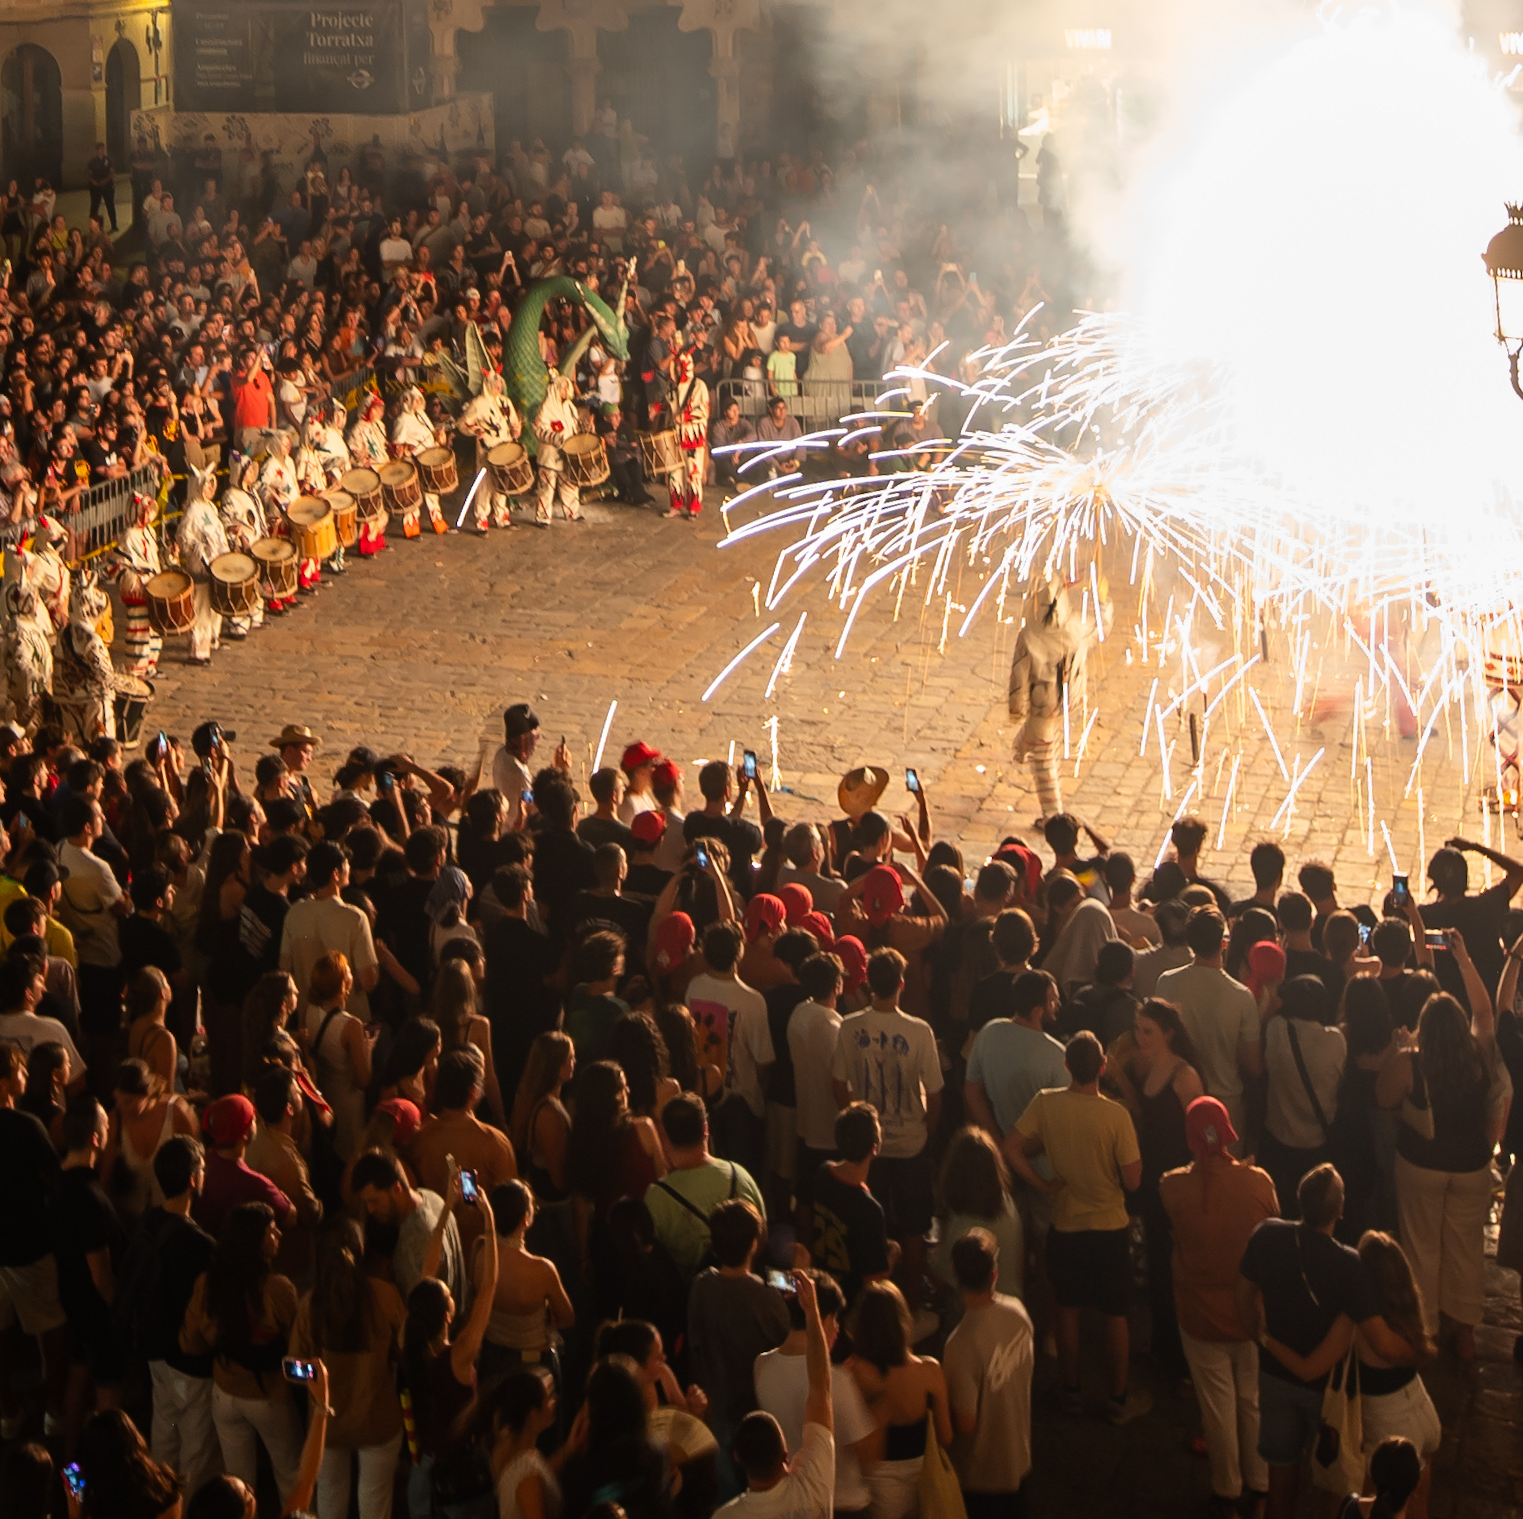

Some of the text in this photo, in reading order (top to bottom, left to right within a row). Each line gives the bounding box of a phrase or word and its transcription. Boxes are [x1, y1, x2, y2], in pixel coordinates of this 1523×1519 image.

[310, 11, 374, 29] Projecte
[306, 31, 374, 47] Torratxa
[303, 51, 375, 68] finançat per
